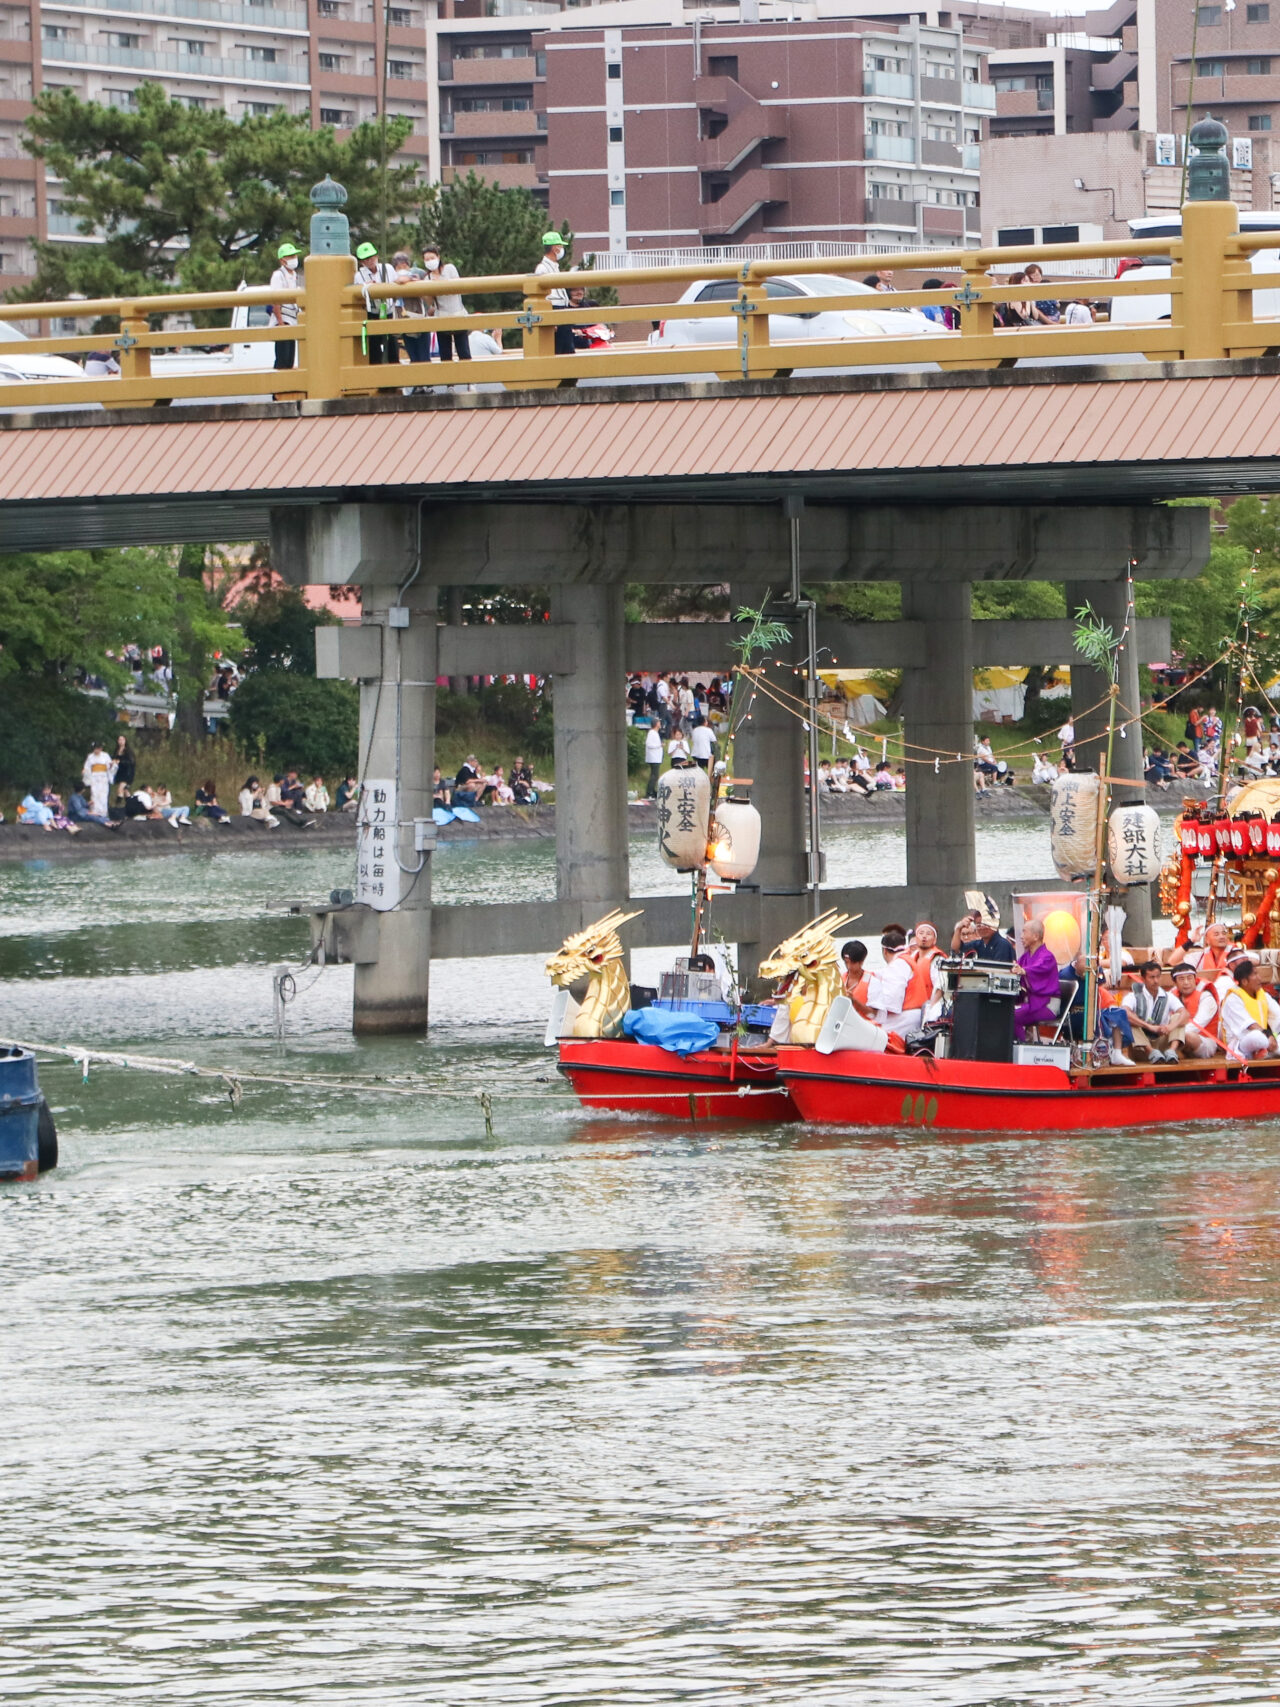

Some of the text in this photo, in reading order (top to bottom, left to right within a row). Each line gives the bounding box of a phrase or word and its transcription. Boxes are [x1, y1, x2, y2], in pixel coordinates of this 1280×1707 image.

[372, 788, 387, 897] 動力船は毎時
[1121, 811, 1149, 877] 建部大社
